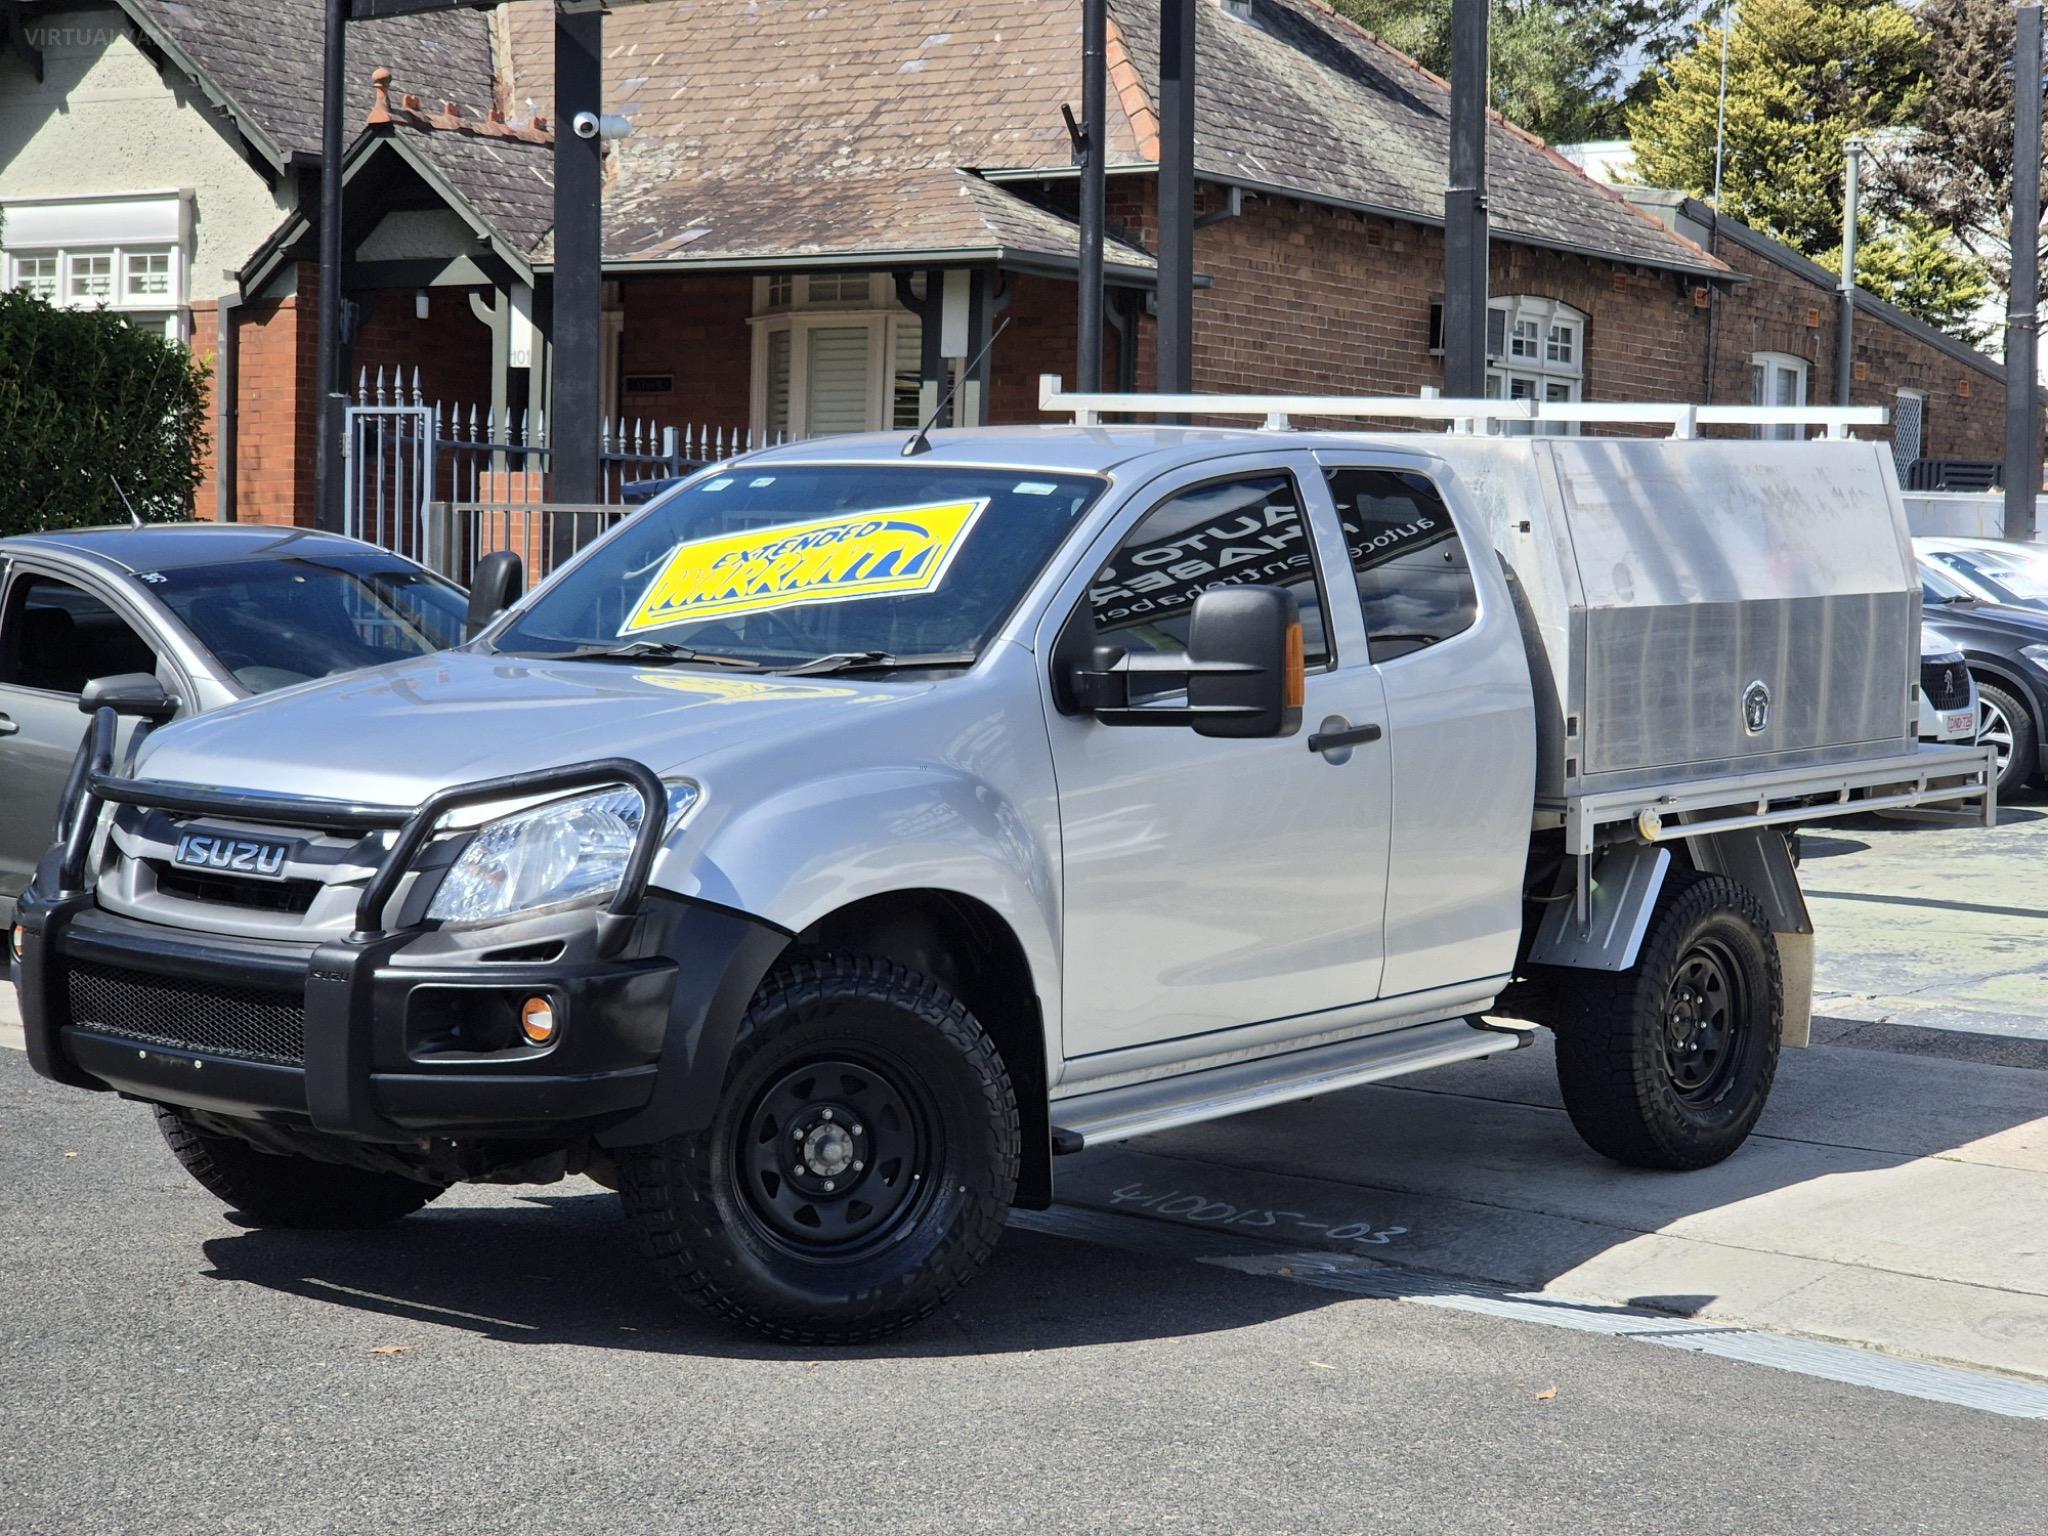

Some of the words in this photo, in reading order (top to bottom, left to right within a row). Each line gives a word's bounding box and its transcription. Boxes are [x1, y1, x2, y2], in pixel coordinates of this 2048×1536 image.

[713, 520, 886, 570] EXTENDED
[651, 535, 940, 610] WARRANTY
[177, 835, 285, 874] ISUZU
